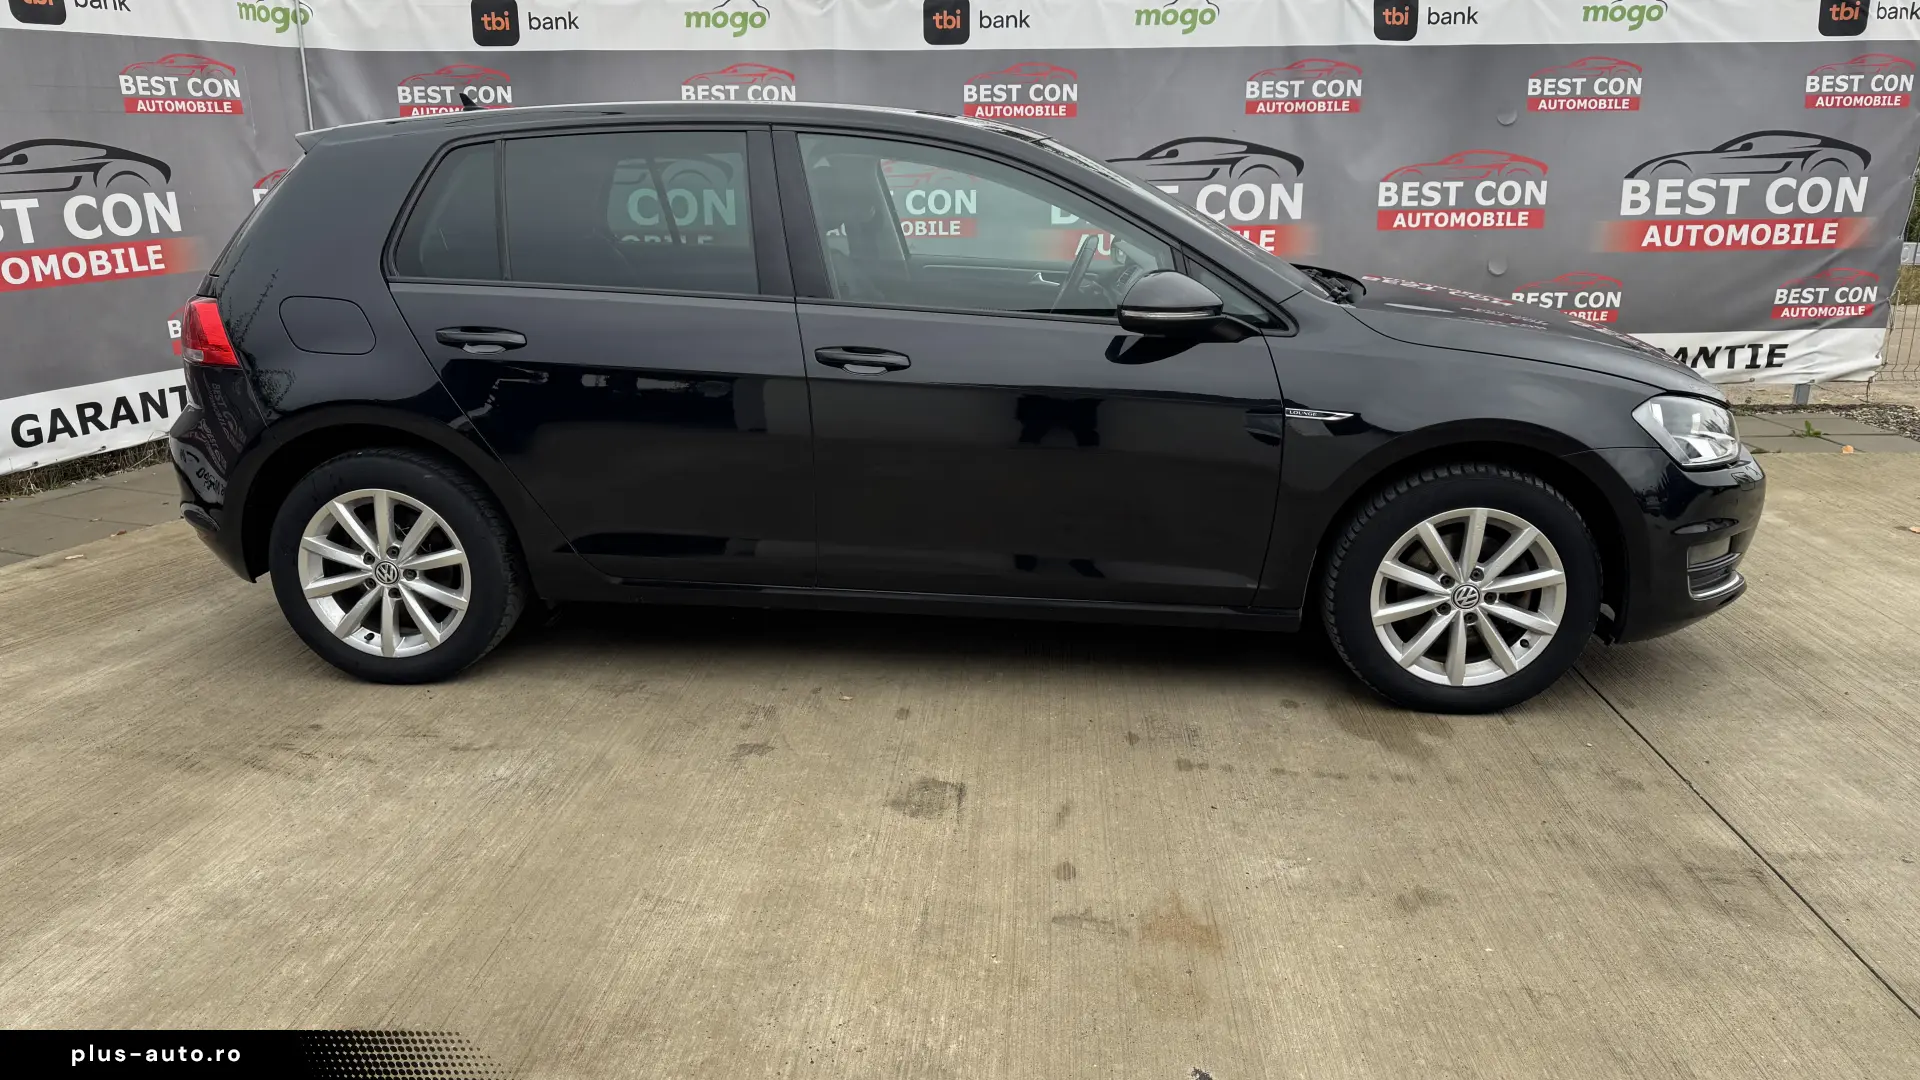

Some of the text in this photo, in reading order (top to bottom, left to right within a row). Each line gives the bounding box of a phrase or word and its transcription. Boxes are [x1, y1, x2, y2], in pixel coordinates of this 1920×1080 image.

[237, 2, 310, 34] mogo
[933, 9, 1031, 29] tbi bank
[1135, 7, 1216, 34] mogo
[1382, 7, 1479, 26] tbi bank
[1583, 3, 1664, 31] mogo
[1829, 1, 1920, 21] tbi bank
[481, 12, 579, 31] tbi bank
[684, 11, 767, 38] mogo
[119, 75, 241, 98] BEST CON
[681, 85, 796, 101] BEST CON
[963, 84, 1078, 102] BEST CON
[1245, 79, 1363, 98] BEST CON
[1527, 77, 1642, 96] BEST CON
[1805, 73, 1915, 93] BEST CON
[397, 86, 512, 103] BEST CON
[1538, 99, 1630, 110] AUTOMOBILE
[1815, 95, 1902, 107] AUTOMOBILE
[136, 100, 233, 113] AUTOMOBILE
[975, 105, 1067, 117] AUTOMOBILE
[1256, 101, 1350, 113] AUTOMOBILE
[905, 189, 977, 215] CON
[1196, 183, 1304, 221] CON
[1378, 180, 1548, 207] BEST CON
[1620, 176, 1869, 216] BEST CON
[63, 191, 182, 240] CON
[626, 187, 737, 226] CON
[1393, 211, 1529, 229] AUTOMOBILE
[1641, 222, 1838, 247] AUTOMOBILE
[1, 244, 165, 285] OMOBILE
[1511, 291, 1622, 308] BEST CON
[1774, 286, 1879, 305] BEST CON
[1780, 305, 1866, 318] AUTOMOBILE
[1659, 343, 1789, 370] ANTIE
[11, 384, 188, 449] GARANT
